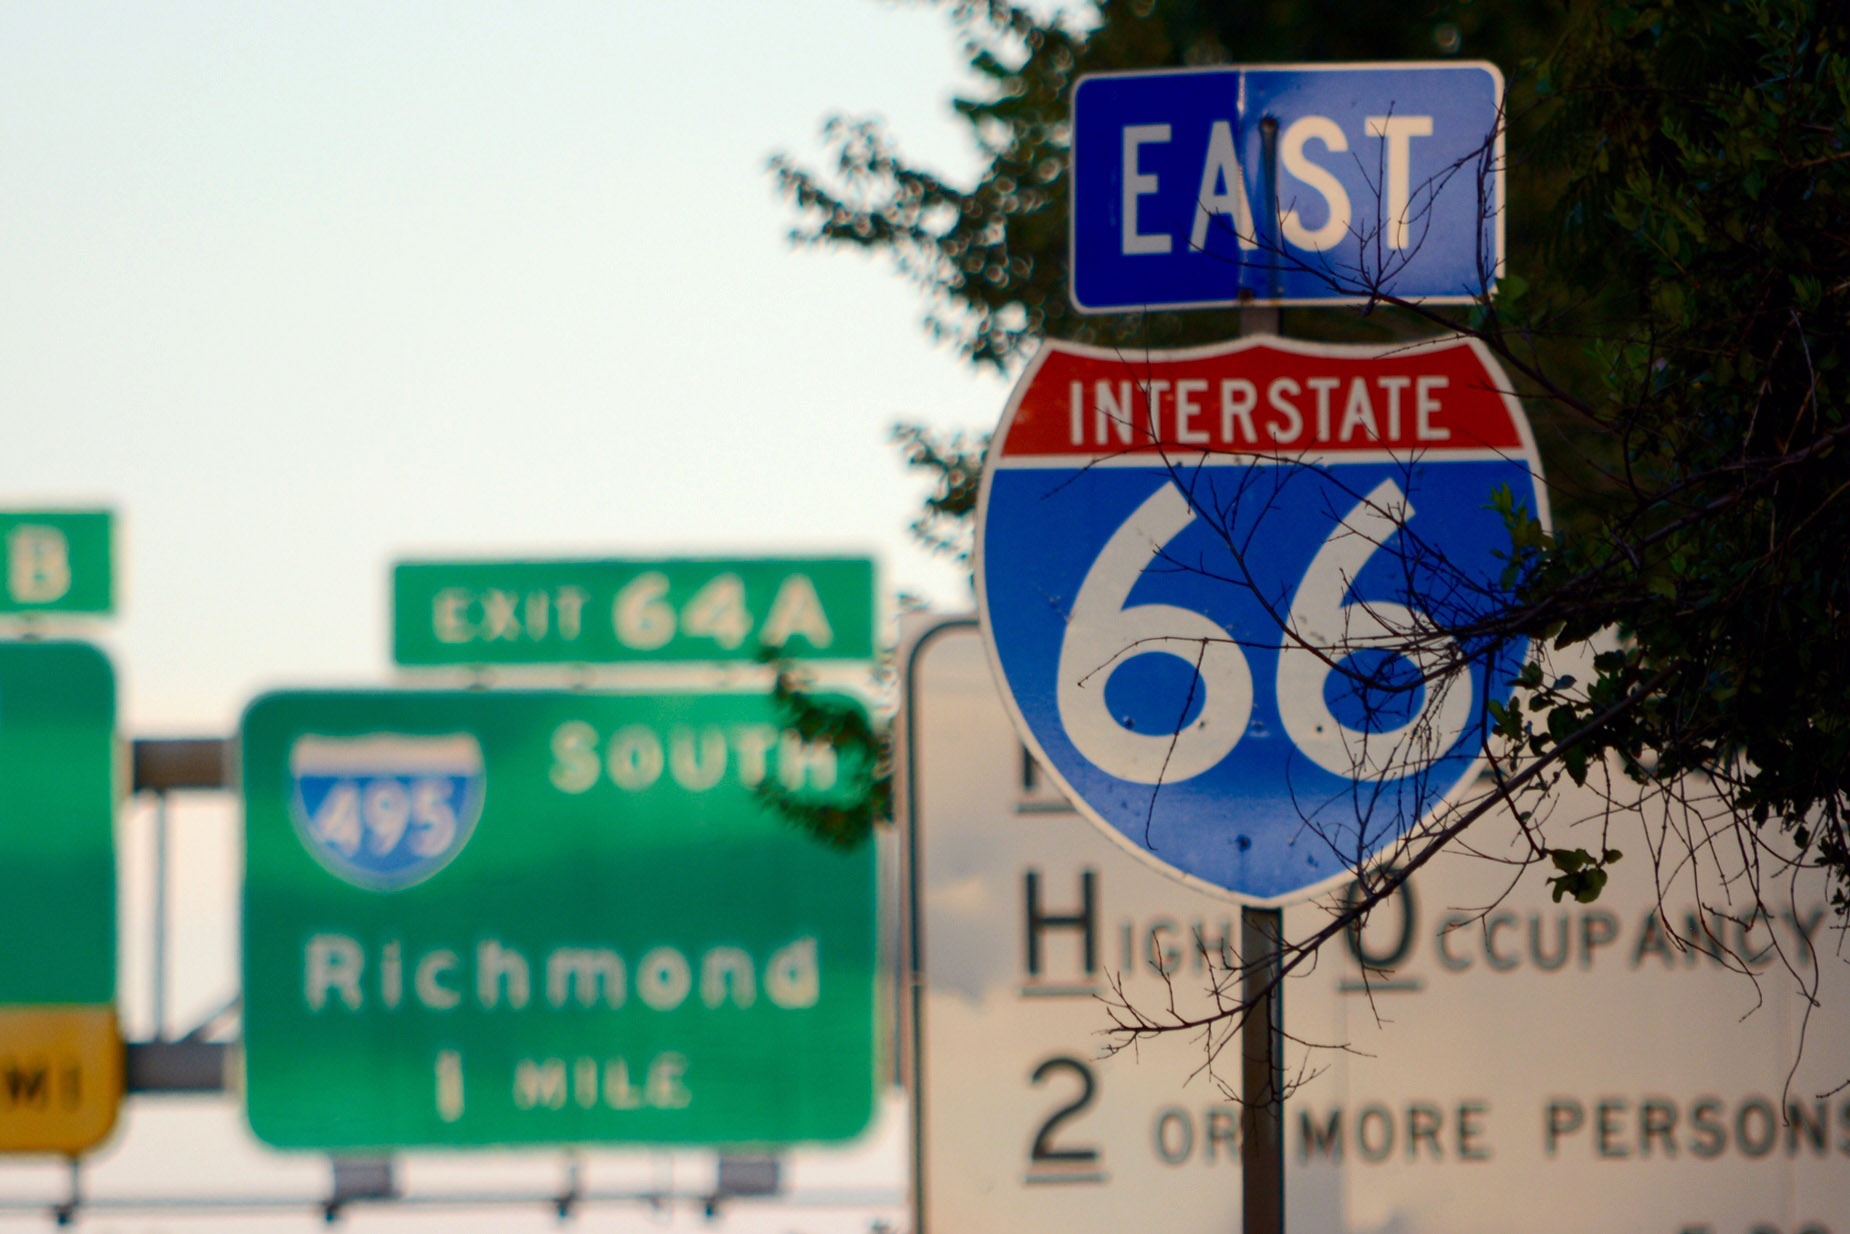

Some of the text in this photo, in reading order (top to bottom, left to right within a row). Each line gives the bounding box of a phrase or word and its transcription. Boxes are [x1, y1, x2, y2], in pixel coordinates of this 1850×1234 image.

[1121, 116, 1434, 256] EAST
[1069, 375, 1450, 446] INTERSTATE
[431, 586, 588, 643] EXIT
[1057, 477, 1473, 785] 66
[549, 720, 838, 793] SOUTH
[313, 776, 457, 857] 495
[305, 934, 820, 1011] Richmond
[435, 1049, 692, 1122] 1 MILE
[1029, 1055, 1850, 1166] 2 OR MORE PERSON
